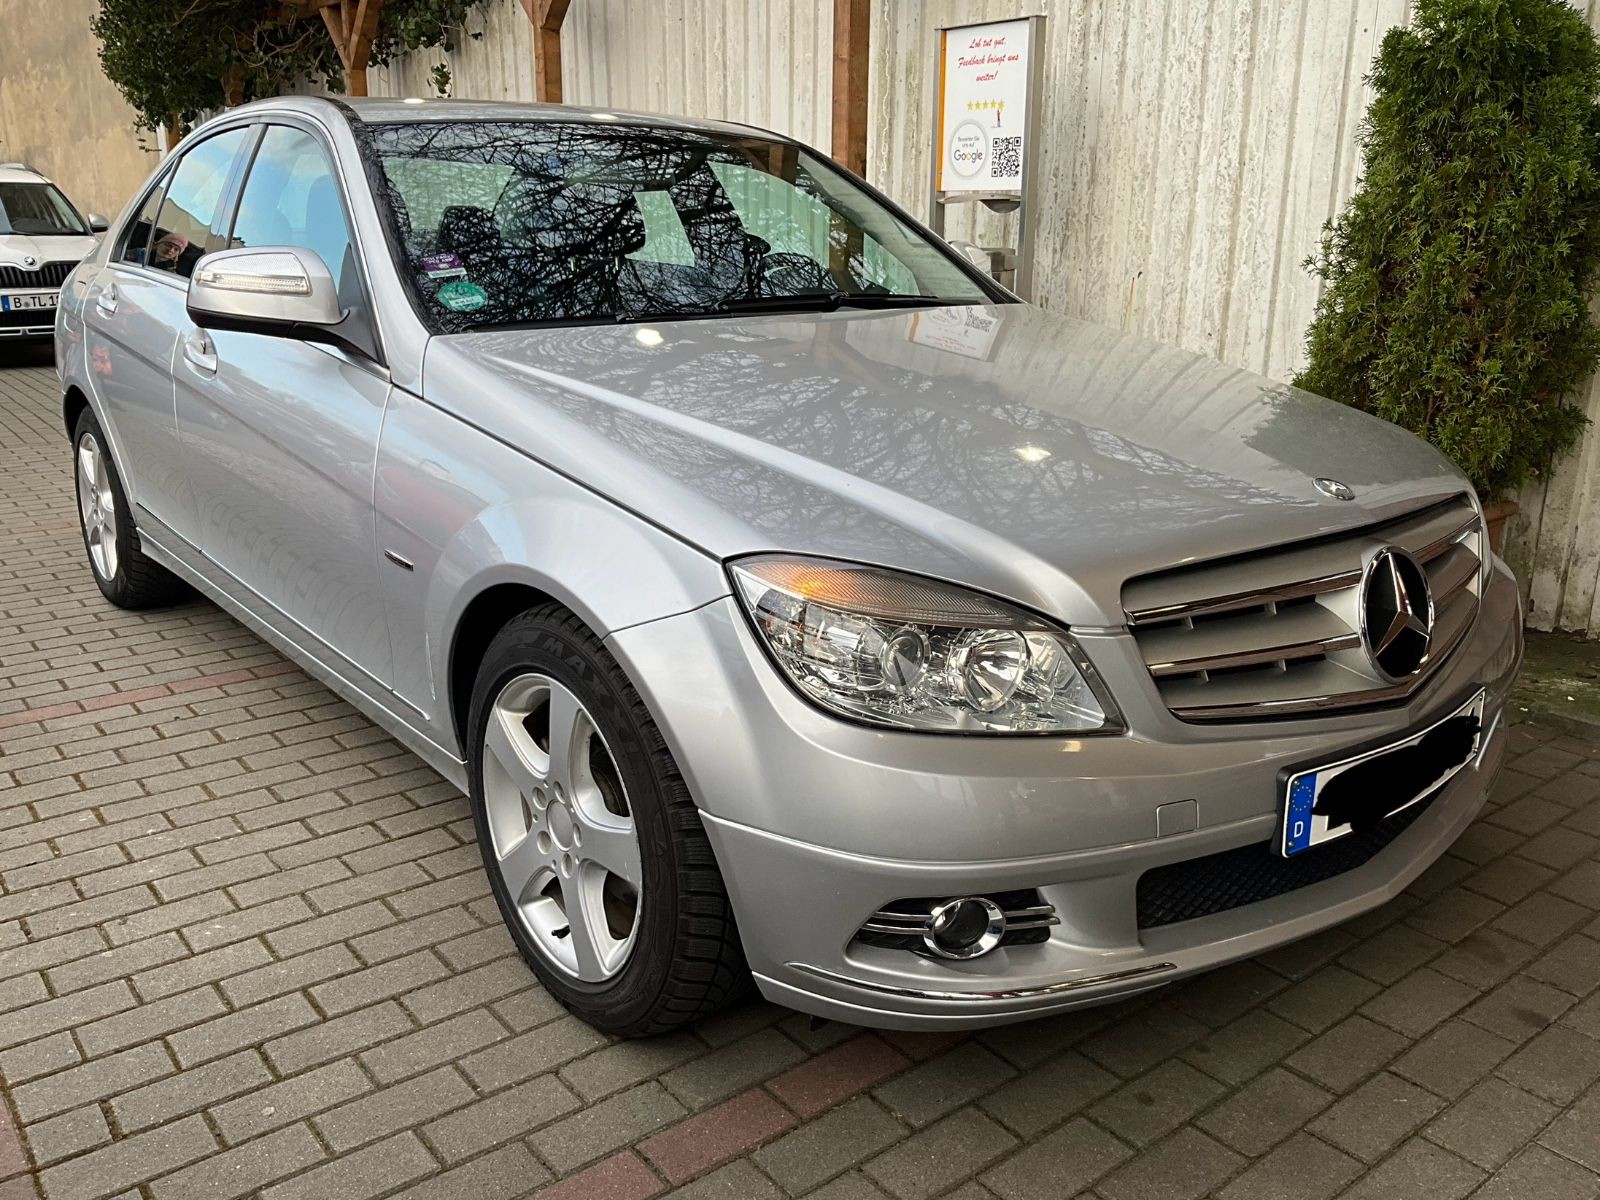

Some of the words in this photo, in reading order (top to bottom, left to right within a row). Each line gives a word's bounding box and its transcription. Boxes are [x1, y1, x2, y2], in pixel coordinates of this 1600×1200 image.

[969, 38, 982, 49] Lob
[983, 38, 993, 47] tut
[958, 55, 985, 68] Feedback
[986, 53, 1006, 66] bringt
[1007, 54, 1019, 62] uns
[976, 70, 998, 81] weiter!
[954, 149, 983, 163] Google
[30, 296, 46, 307] TL
[1294, 821, 1304, 838] D
